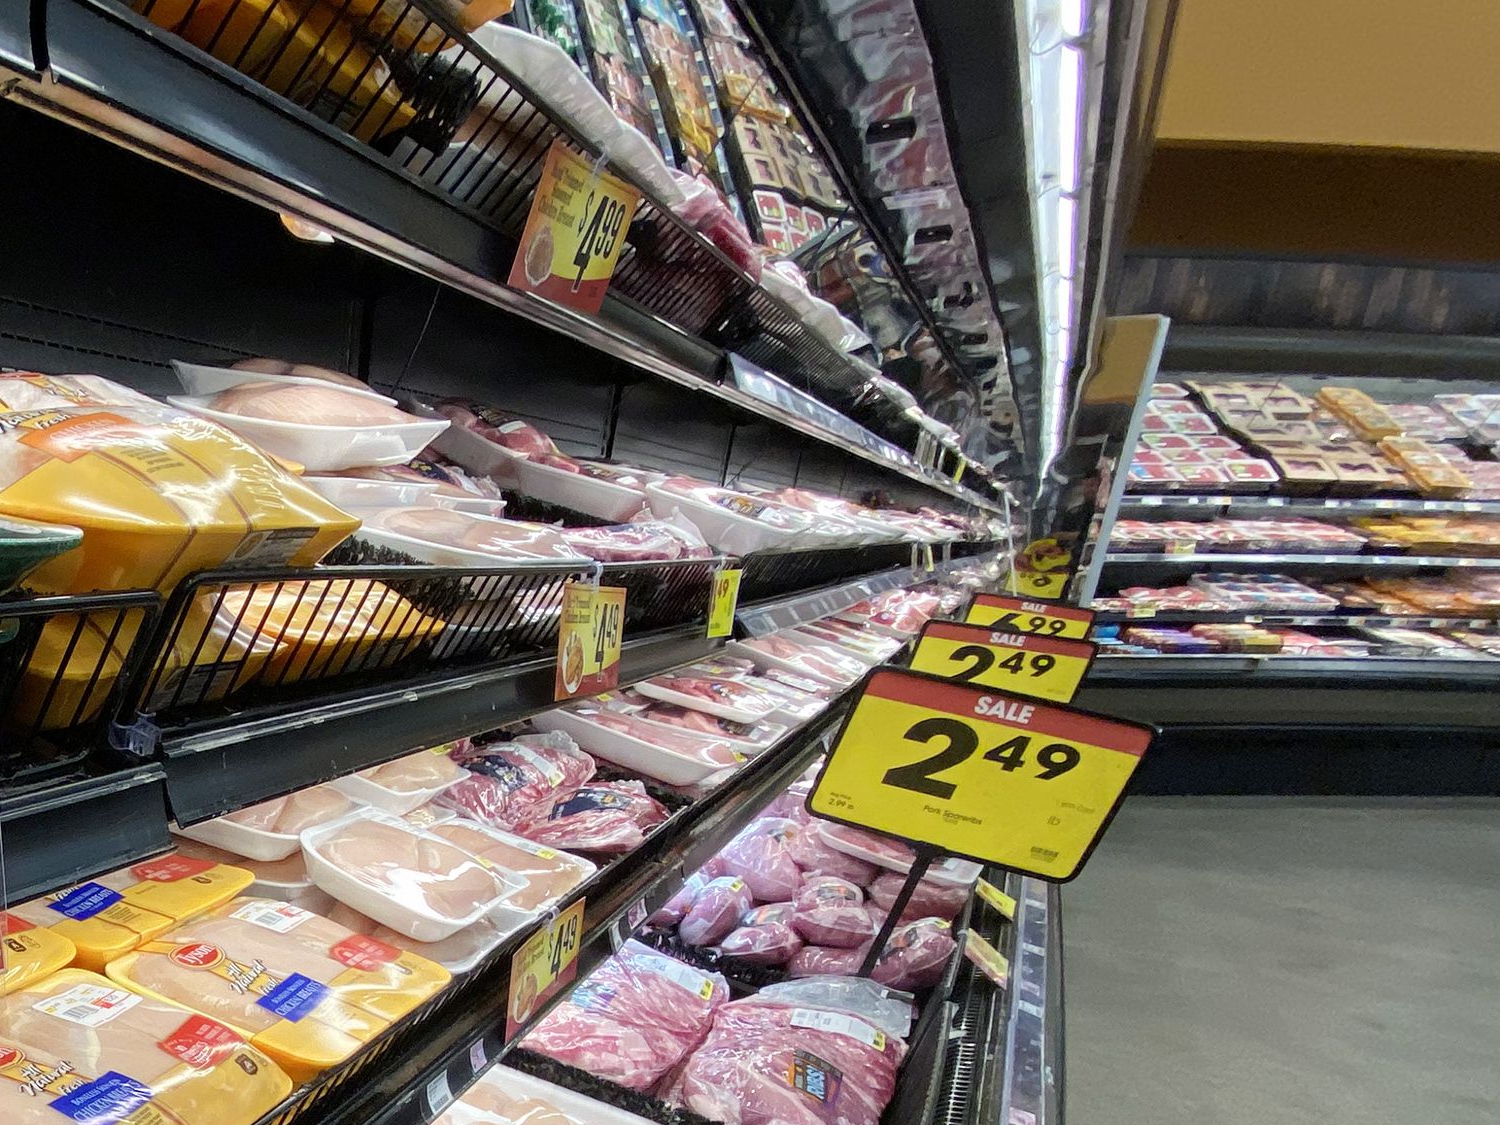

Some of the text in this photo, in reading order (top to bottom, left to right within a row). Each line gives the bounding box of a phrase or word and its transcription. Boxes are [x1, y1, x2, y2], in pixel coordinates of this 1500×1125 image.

[1020, 601, 1047, 614] SALE
[988, 631, 1026, 648] SALE
[973, 694, 1036, 725] SALE
[177, 943, 217, 967] Tyson
[72, 1098, 111, 1122] CHICKEN
